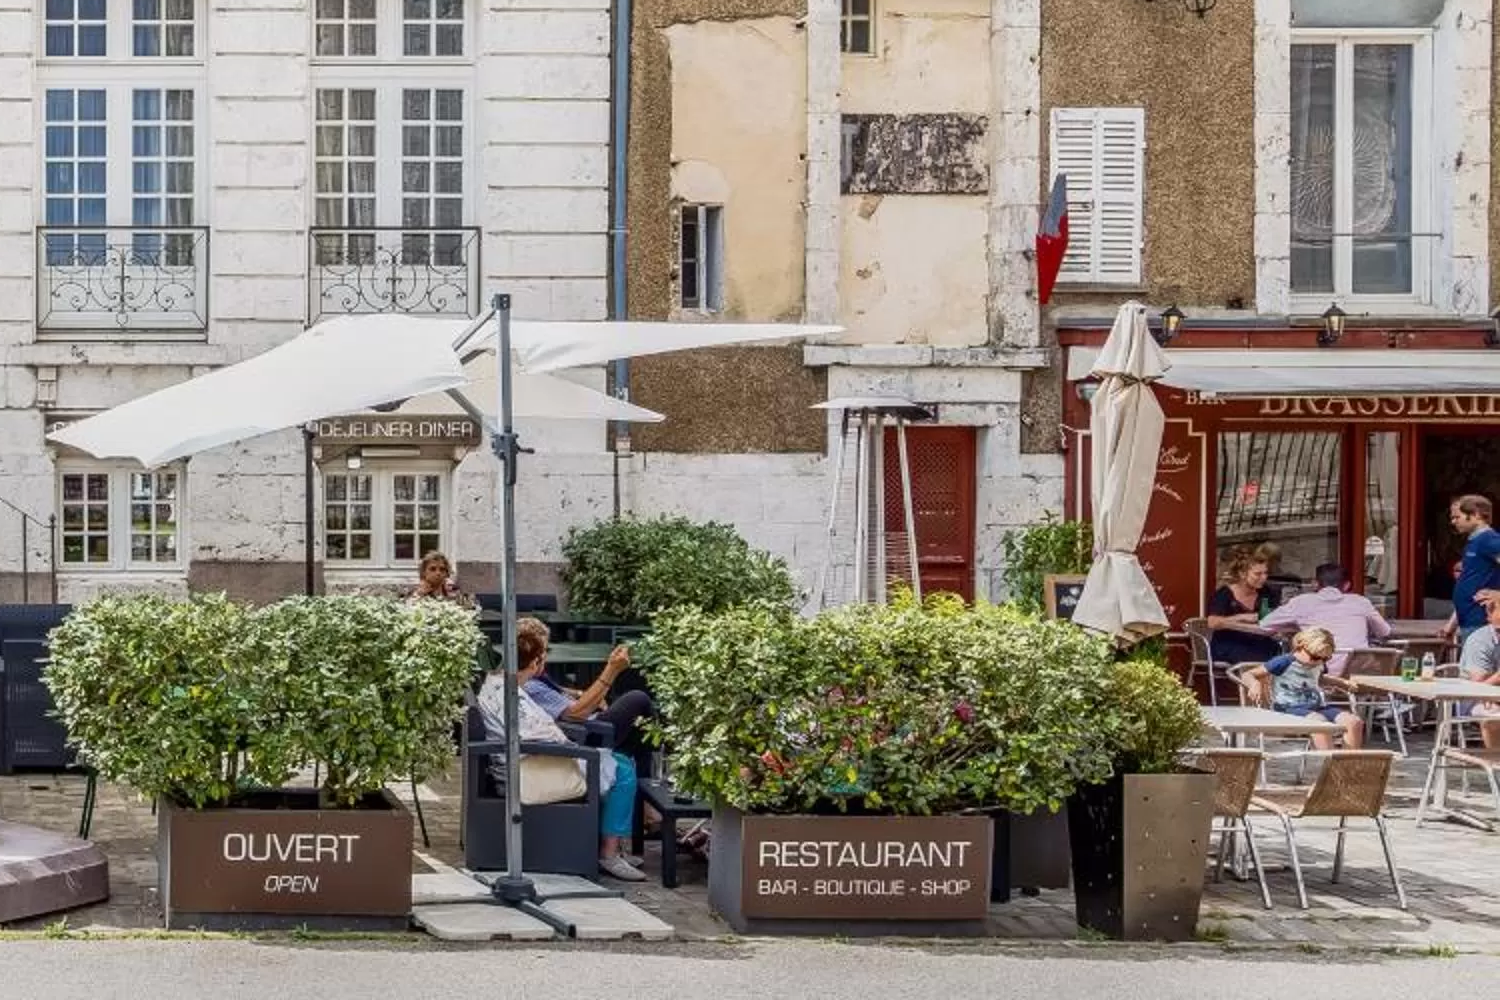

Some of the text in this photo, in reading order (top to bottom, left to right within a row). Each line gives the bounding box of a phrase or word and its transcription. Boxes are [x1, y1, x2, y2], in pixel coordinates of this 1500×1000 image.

[223, 832, 361, 863] OUVERT
[758, 840, 972, 868] RESTAURANT
[263, 874, 319, 894] OPEN
[757, 878, 798, 896] BAR
[813, 878, 905, 896] BOUTIQUE
[920, 878, 972, 896] SHOP
